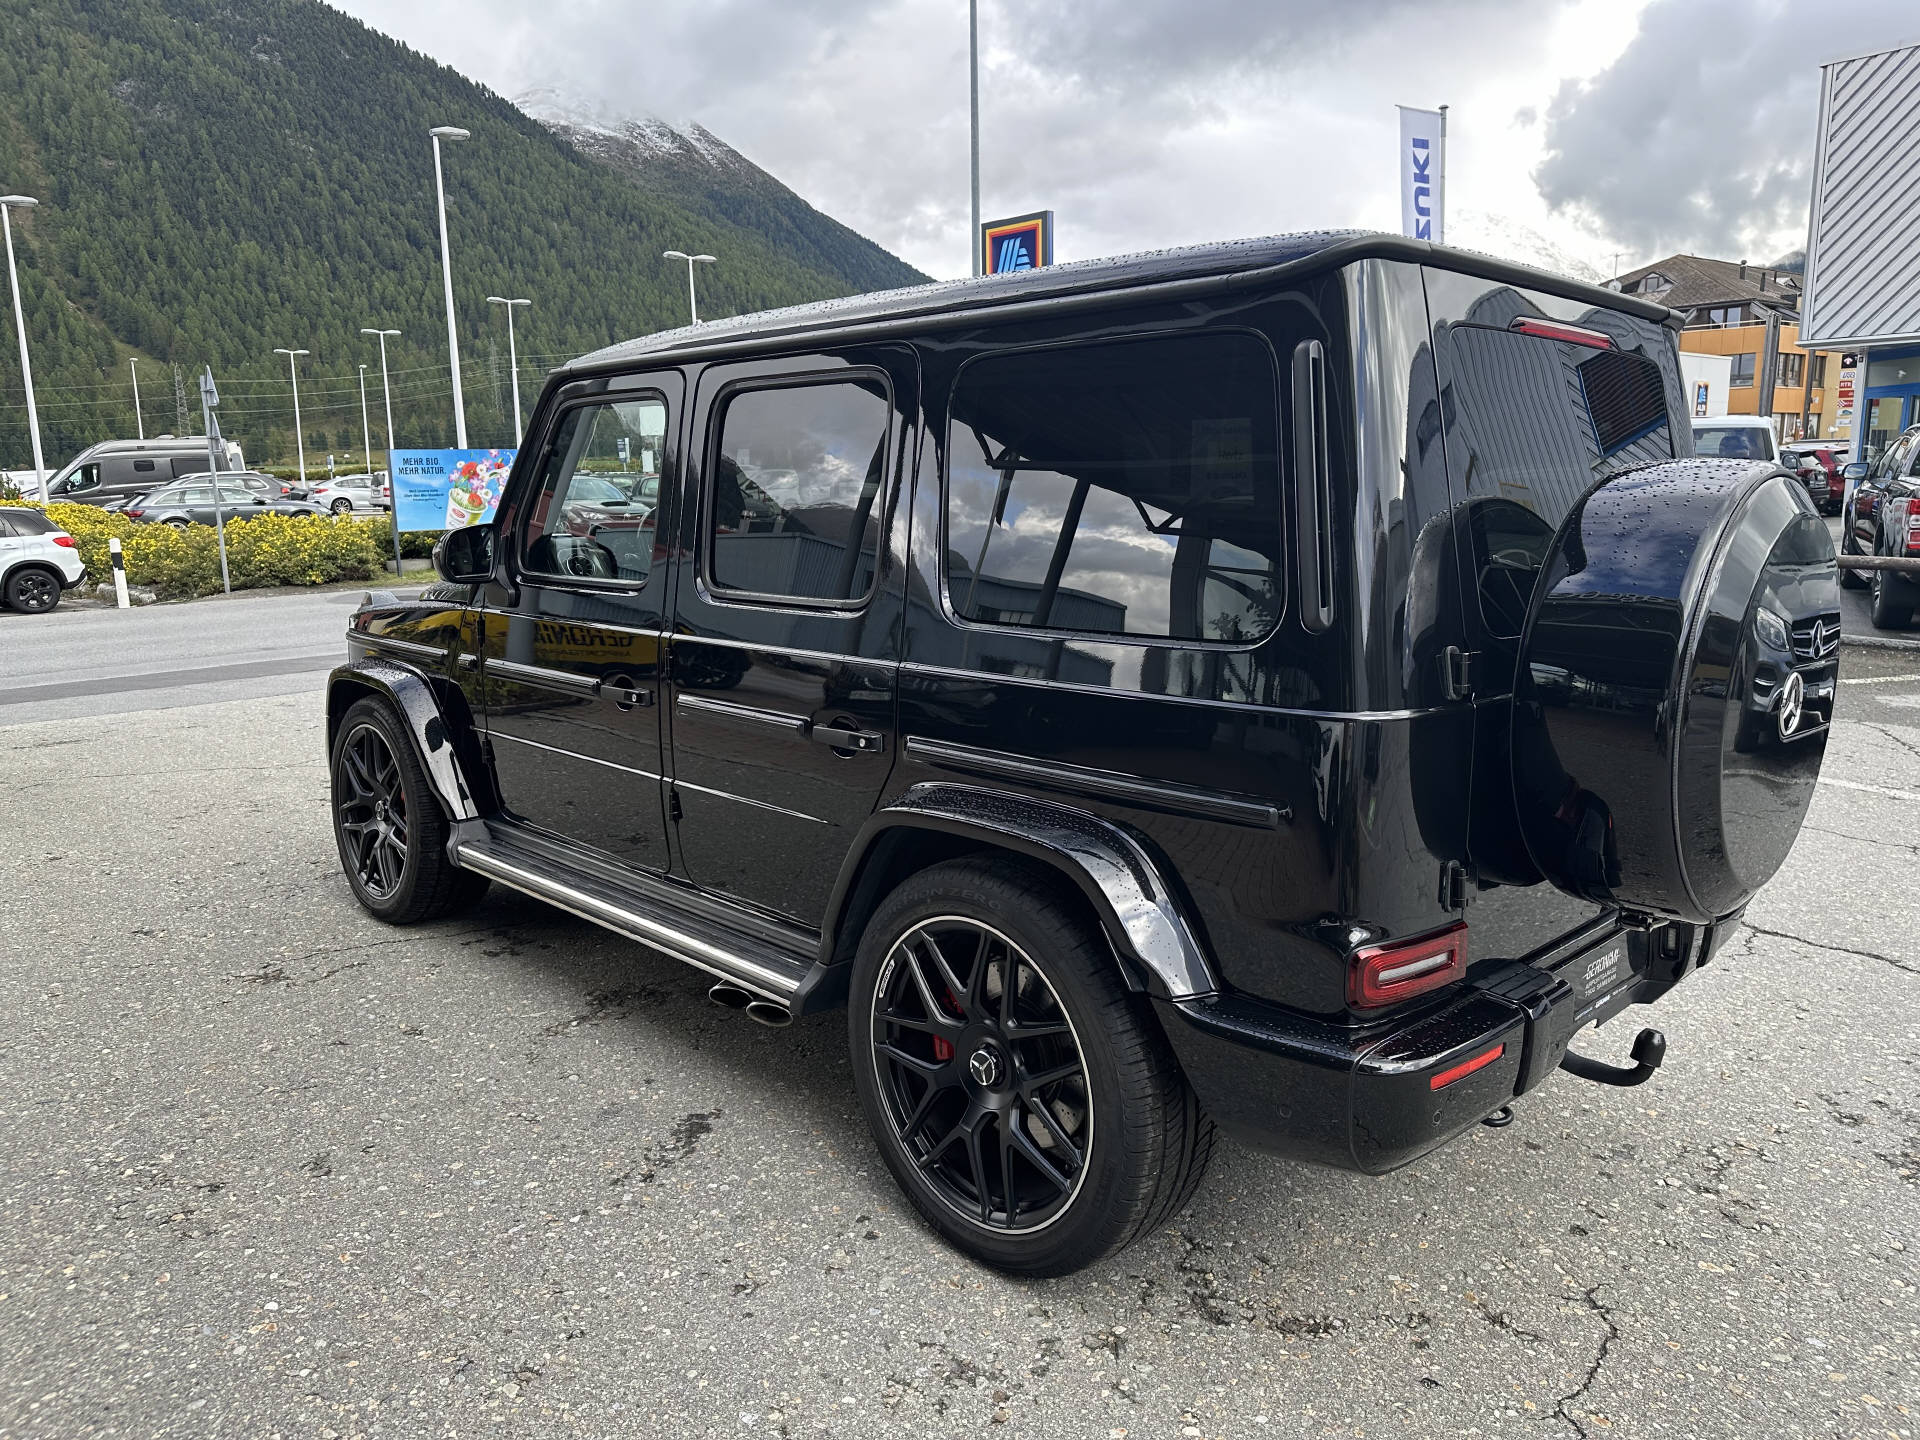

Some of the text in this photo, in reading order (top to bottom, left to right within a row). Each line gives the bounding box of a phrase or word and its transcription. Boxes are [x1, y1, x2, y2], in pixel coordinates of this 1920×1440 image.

[1412, 137, 1431, 240] ZUKI
[402, 457, 423, 466] MEHR
[398, 466, 447, 475] MEHR NATUR.
